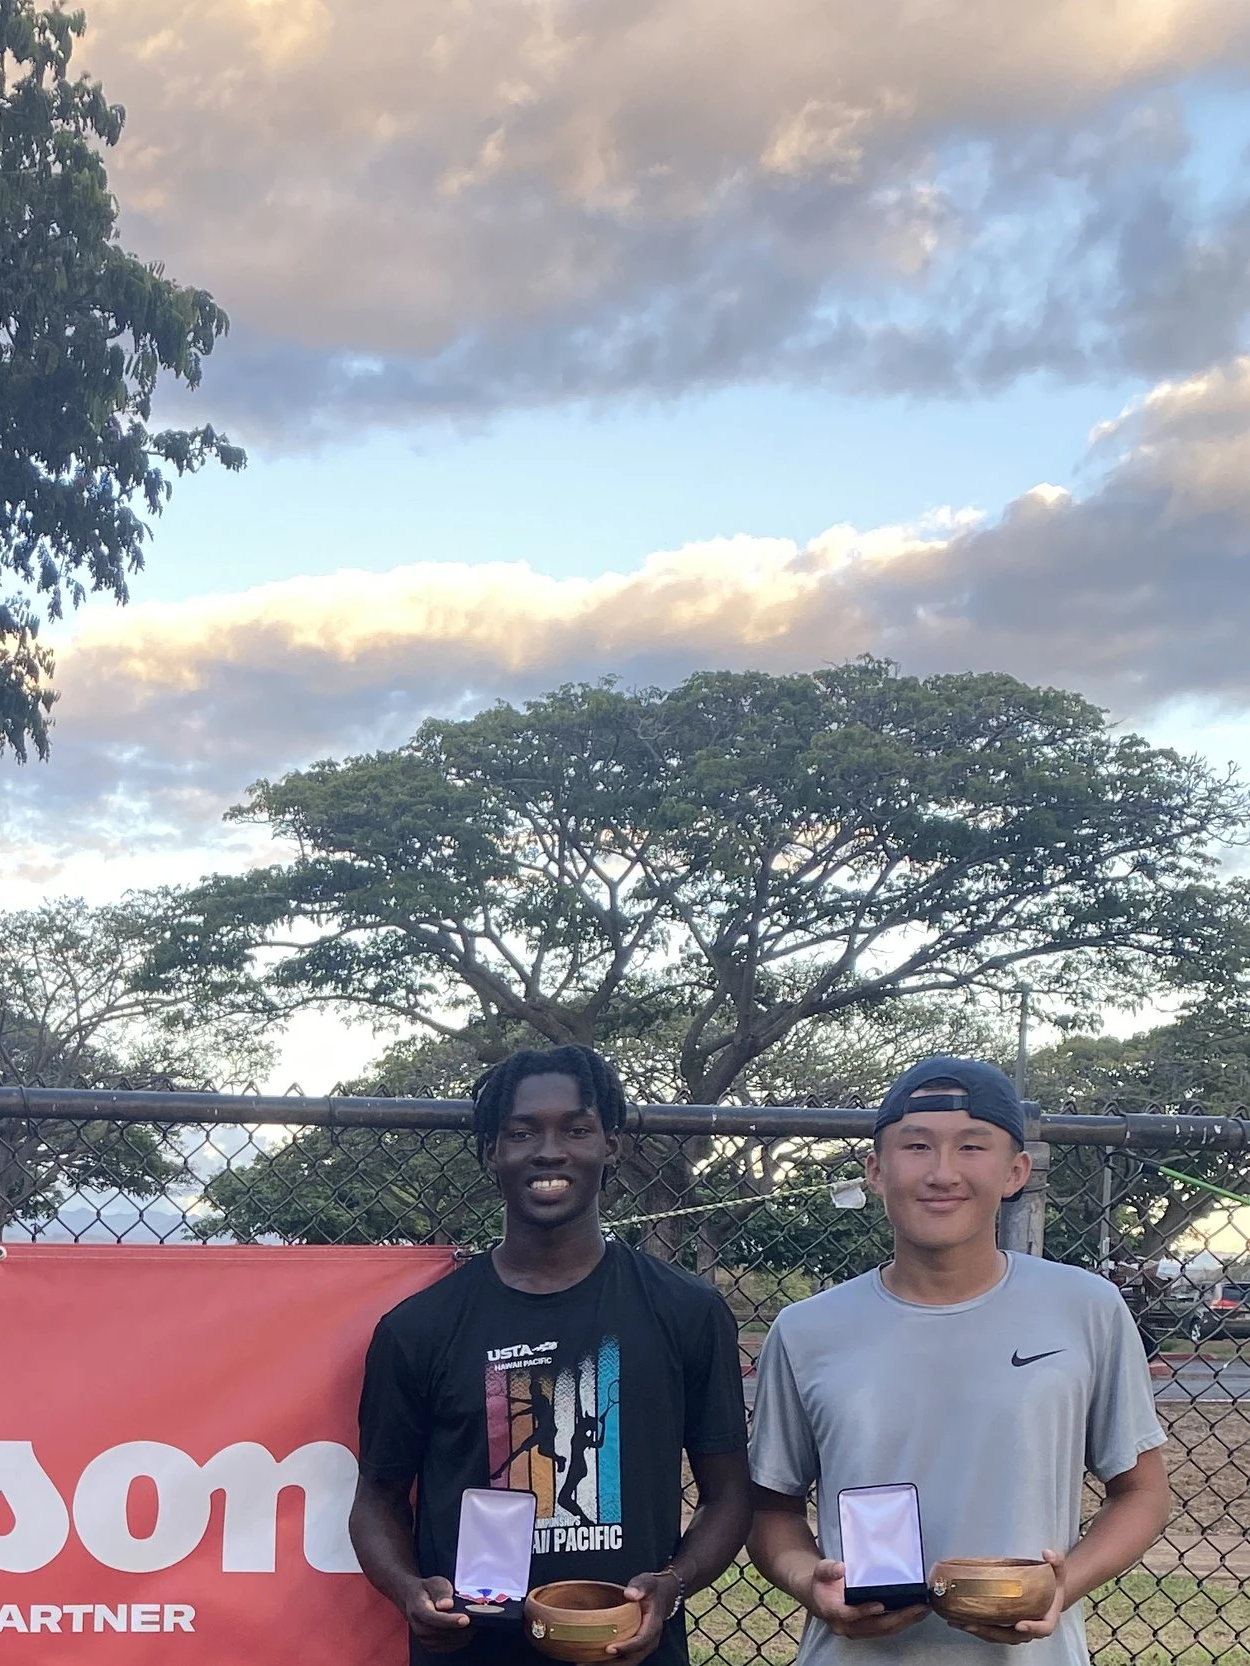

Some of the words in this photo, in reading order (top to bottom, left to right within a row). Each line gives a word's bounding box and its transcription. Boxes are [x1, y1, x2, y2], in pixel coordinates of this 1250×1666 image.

[487, 1344, 534, 1361] USTA
[494, 1360, 522, 1371] HAWAII
[523, 1357, 552, 1367] PACIFIC
[532, 1529, 550, 1554] AII
[554, 1525, 622, 1552] PACIFIC
